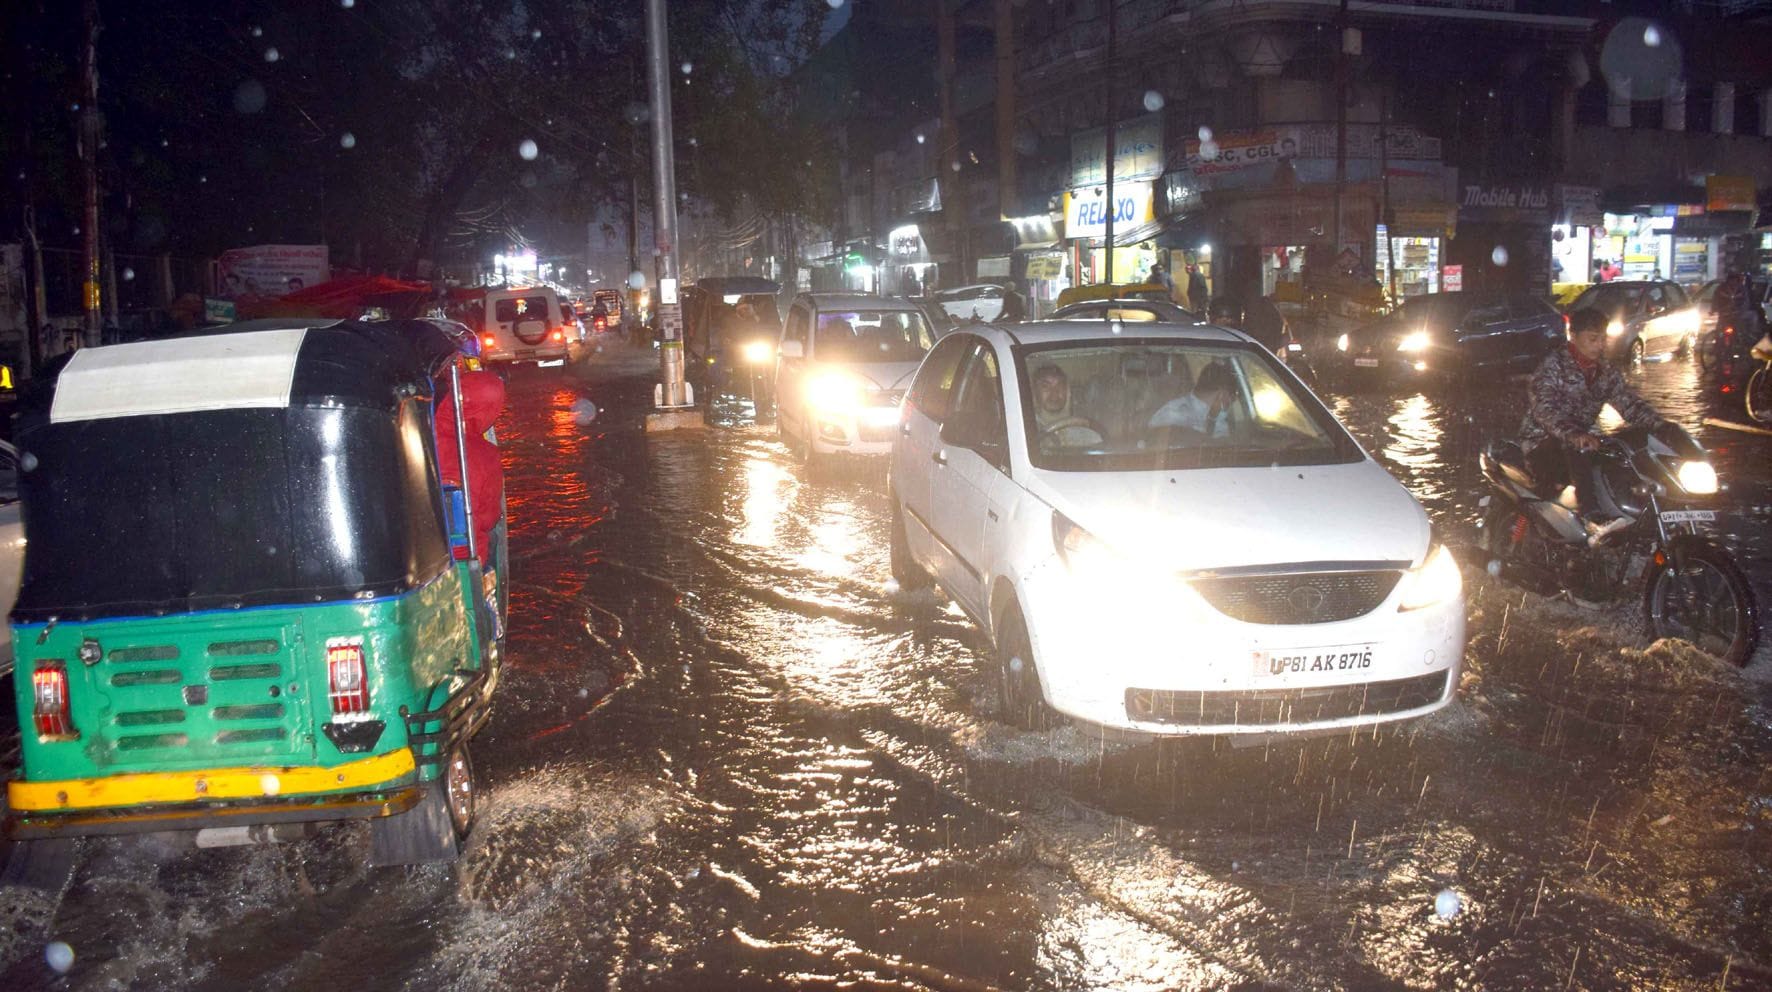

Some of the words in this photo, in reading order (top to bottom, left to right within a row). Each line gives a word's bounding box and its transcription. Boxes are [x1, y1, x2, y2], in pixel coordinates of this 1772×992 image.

[1245, 145, 1279, 159] CGL
[1464, 185, 1516, 207] Mobile
[1518, 187, 1549, 208] Hub
[1269, 655, 1307, 675] UP81
[1310, 654, 1336, 671] AK
[1338, 651, 1373, 670] 8716
